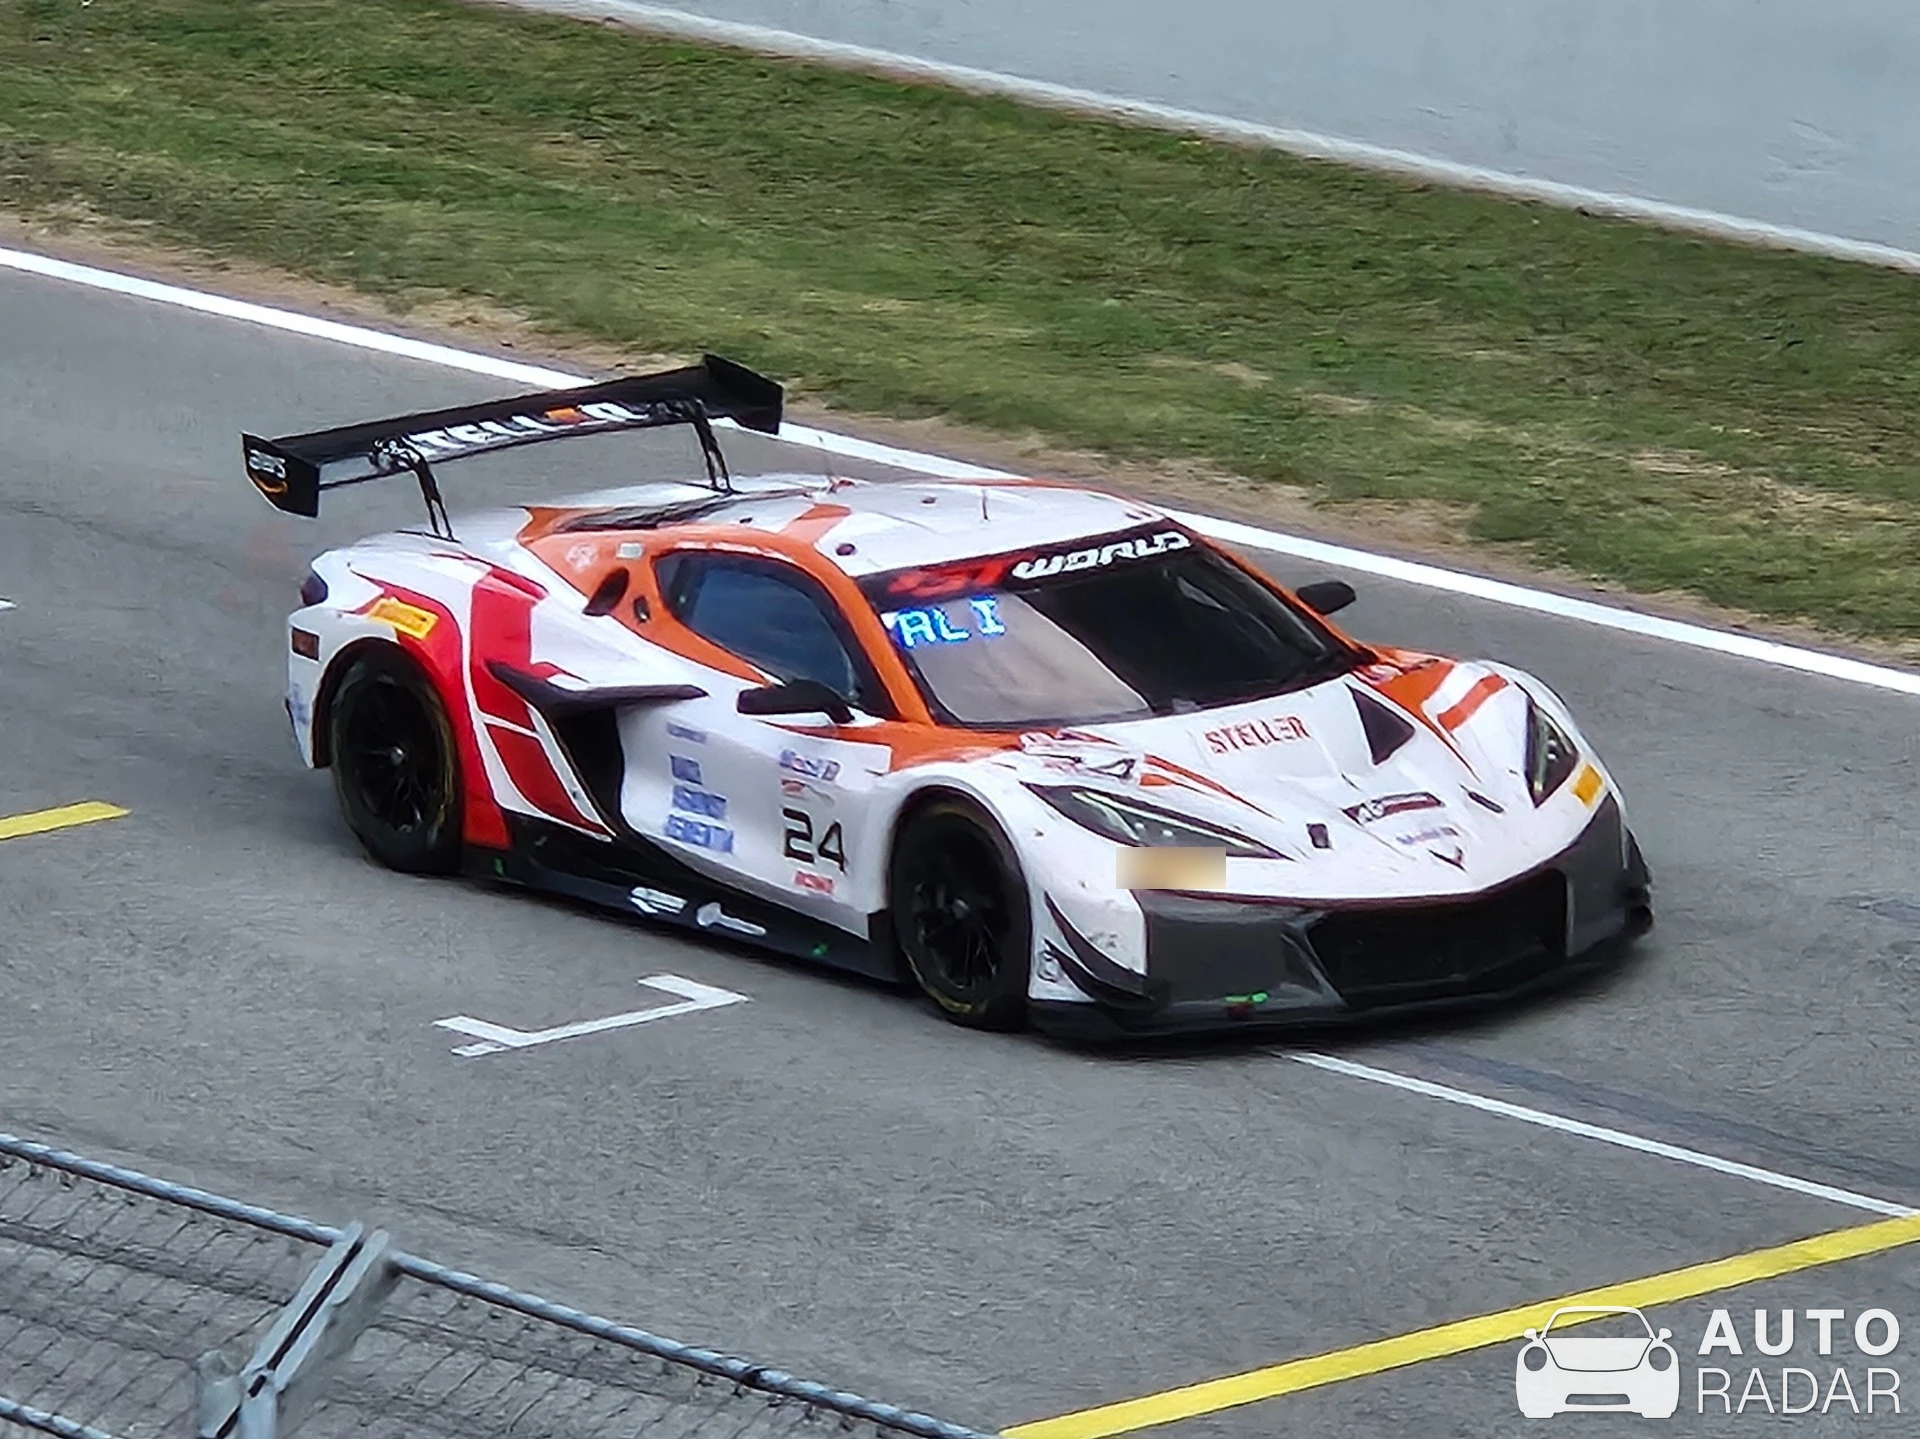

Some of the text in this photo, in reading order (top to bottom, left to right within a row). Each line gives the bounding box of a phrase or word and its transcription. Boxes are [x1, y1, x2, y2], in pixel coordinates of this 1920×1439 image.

[1012, 531, 1191, 579] WORLD
[895, 597, 1006, 648] ALI
[782, 807, 845, 874] 24
